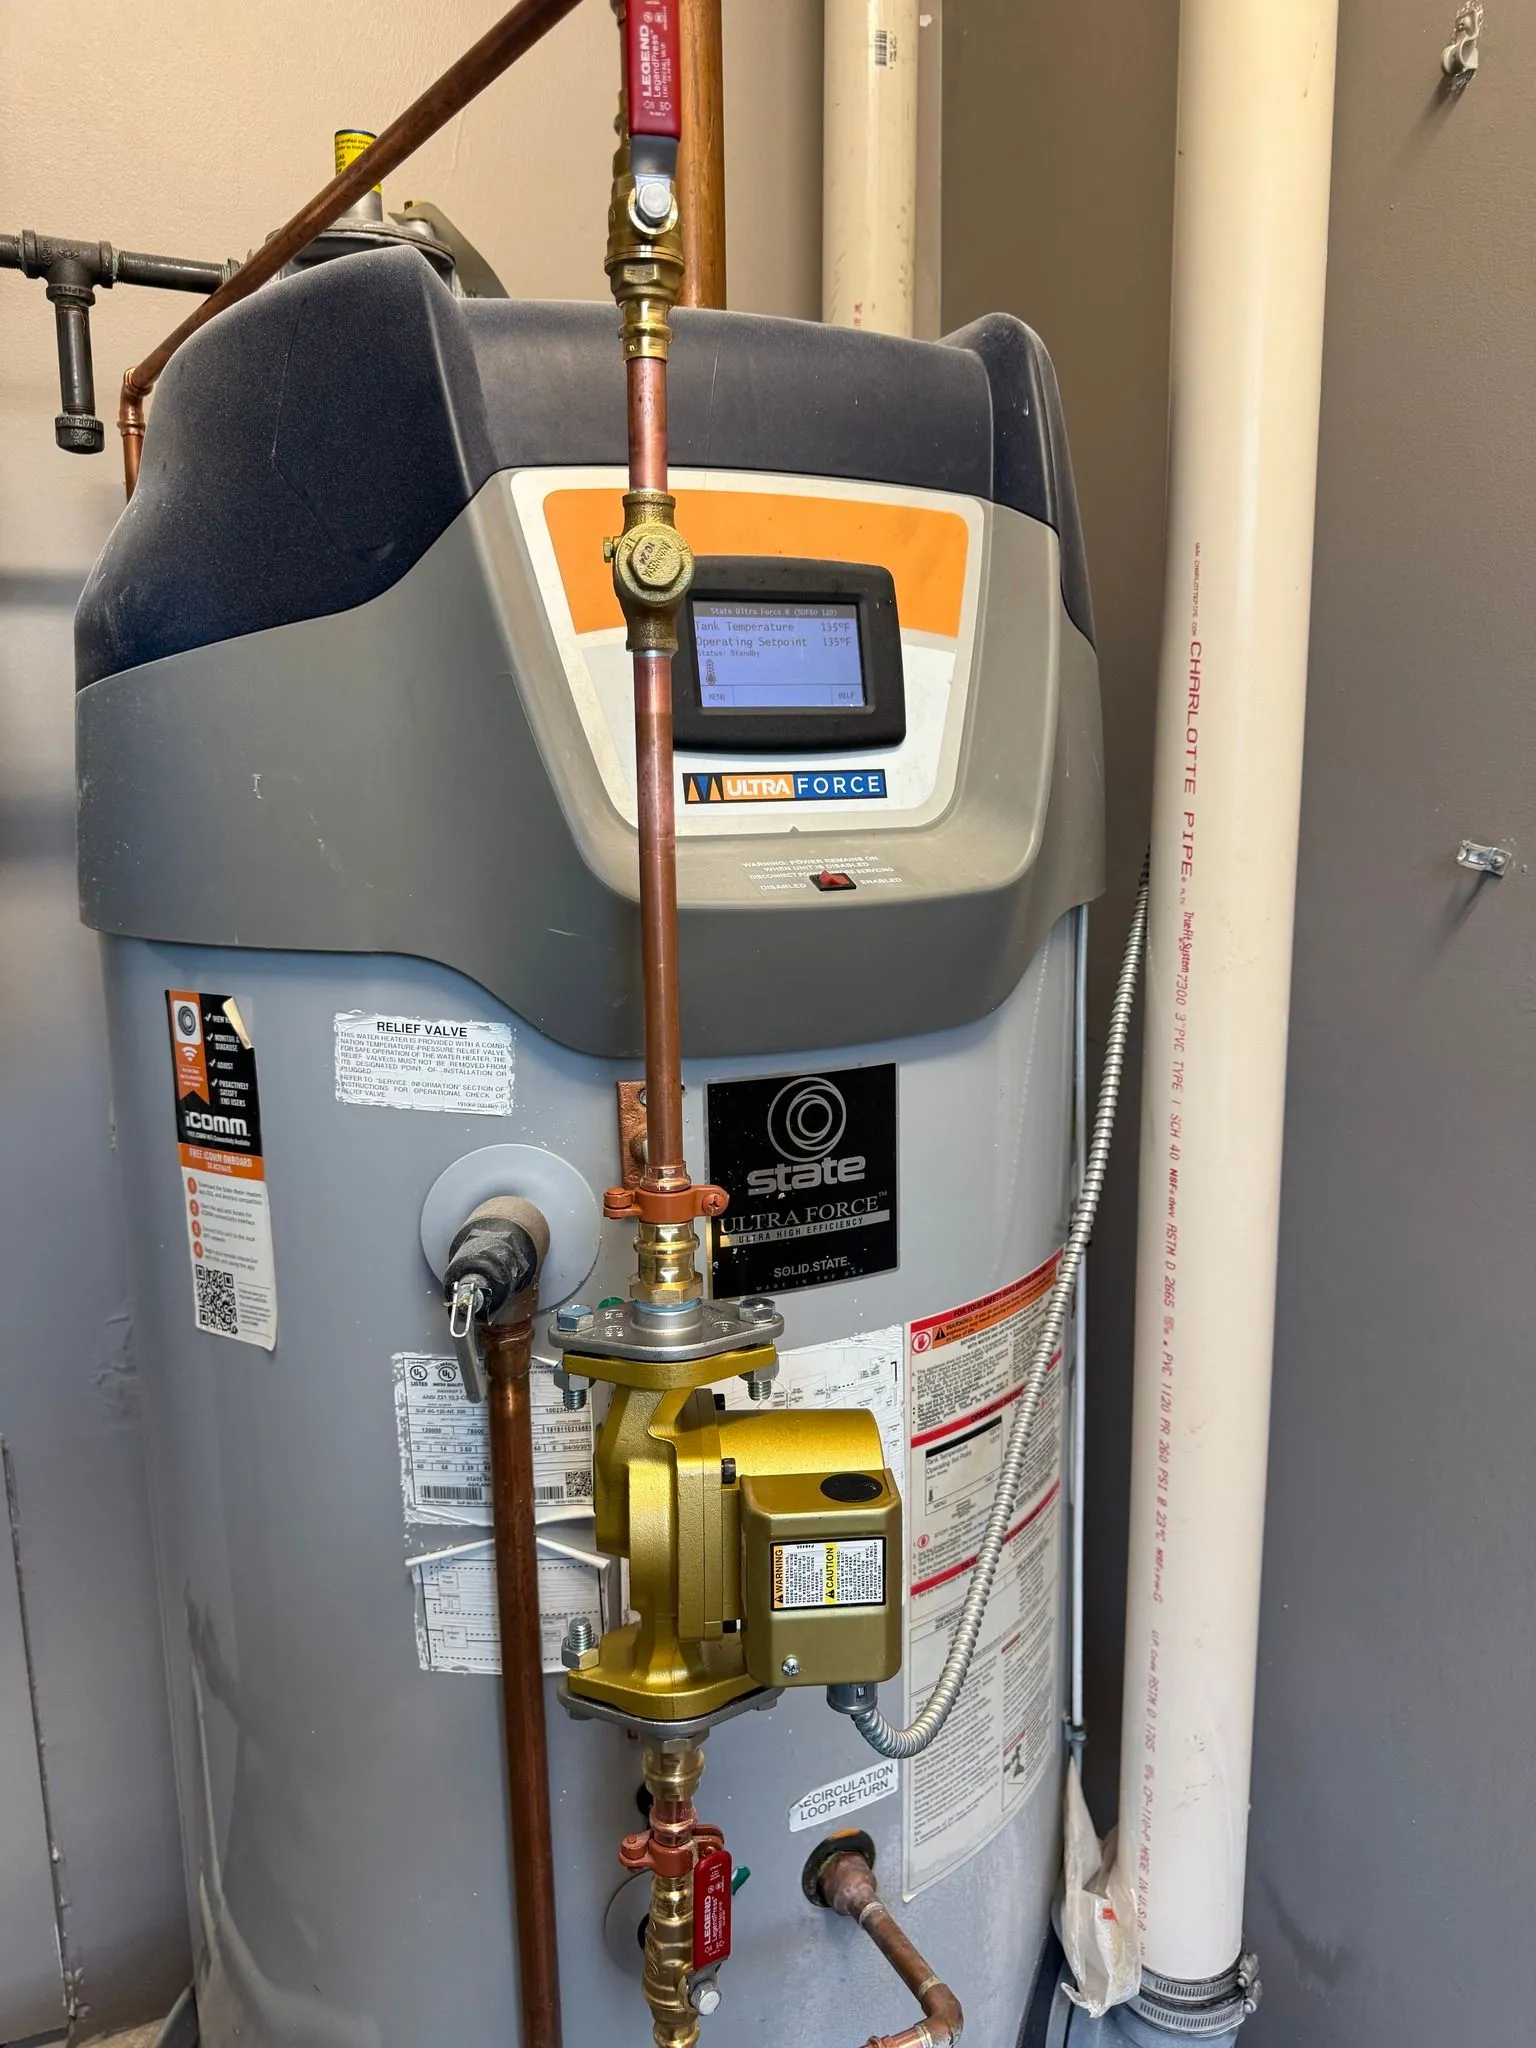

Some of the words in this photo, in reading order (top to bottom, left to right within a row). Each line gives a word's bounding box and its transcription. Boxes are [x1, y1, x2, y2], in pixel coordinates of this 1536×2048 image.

[639, 25, 652, 96] LEGEND
[696, 621, 720, 632] Tank
[727, 622, 794, 634] Temperature
[696, 637, 753, 648] Operating
[758, 638, 808, 648] Setpoint
[730, 650, 760, 658] Standby
[1184, 641, 1202, 794] CHARLOTTE
[726, 778, 791, 796] ULTRA
[797, 776, 881, 794] FORCE
[749, 872, 798, 880] DISCONNECT
[860, 877, 902, 885] ENABLED
[1178, 942, 1193, 972] System
[1175, 974, 1188, 1006] 7300
[377, 1021, 421, 1034] RELIEF
[424, 1024, 468, 1038] VALVE
[381, 1035, 409, 1043] HEATER
[418, 1038, 454, 1047] PROVIDED
[456, 1040, 474, 1048] WITH
[341, 1038, 364, 1046] NATION
[456, 1047, 481, 1055] RELIEF
[372, 1048, 410, 1057] OPERATION
[341, 1052, 362, 1060] RELIEF
[450, 1060, 485, 1069] REMOVED
[218, 1080, 249, 1090] PROACTIVELY
[1171, 1061, 1184, 1092] TYPE
[1169, 1114, 1181, 1138] SCH
[1169, 1144, 1180, 1161] 40
[748, 1155, 866, 1196] state
[718, 1210, 801, 1234] ULTRA
[738, 1232, 770, 1244] ULTRA
[776, 1228, 801, 1238] HIGH
[807, 1216, 864, 1234] EFFICIENCY
[1165, 1223, 1178, 1255] ASTM
[1165, 1261, 1176, 1271] D
[756, 1280, 787, 1291] MADE
[816, 1274, 836, 1282] THE
[1163, 1276, 1175, 1308] 2665
[1161, 1351, 1173, 1376] PVC
[1160, 1383, 1172, 1412] 1120
[1159, 1417, 1171, 1435] PR
[1158, 1439, 1169, 1463] 260
[1157, 1467, 1168, 1492] PSI
[775, 1550, 783, 1593] WARNING
[826, 1548, 834, 1588] CAUTION
[1147, 1674, 1159, 1707] ASTM
[1146, 1708, 1157, 1718] D
[800, 1800, 836, 1820] LOOP
[839, 1778, 889, 1807] RETURN
[1138, 1877, 1149, 1894] IN
[704, 1895, 712, 1946] LEGEND
